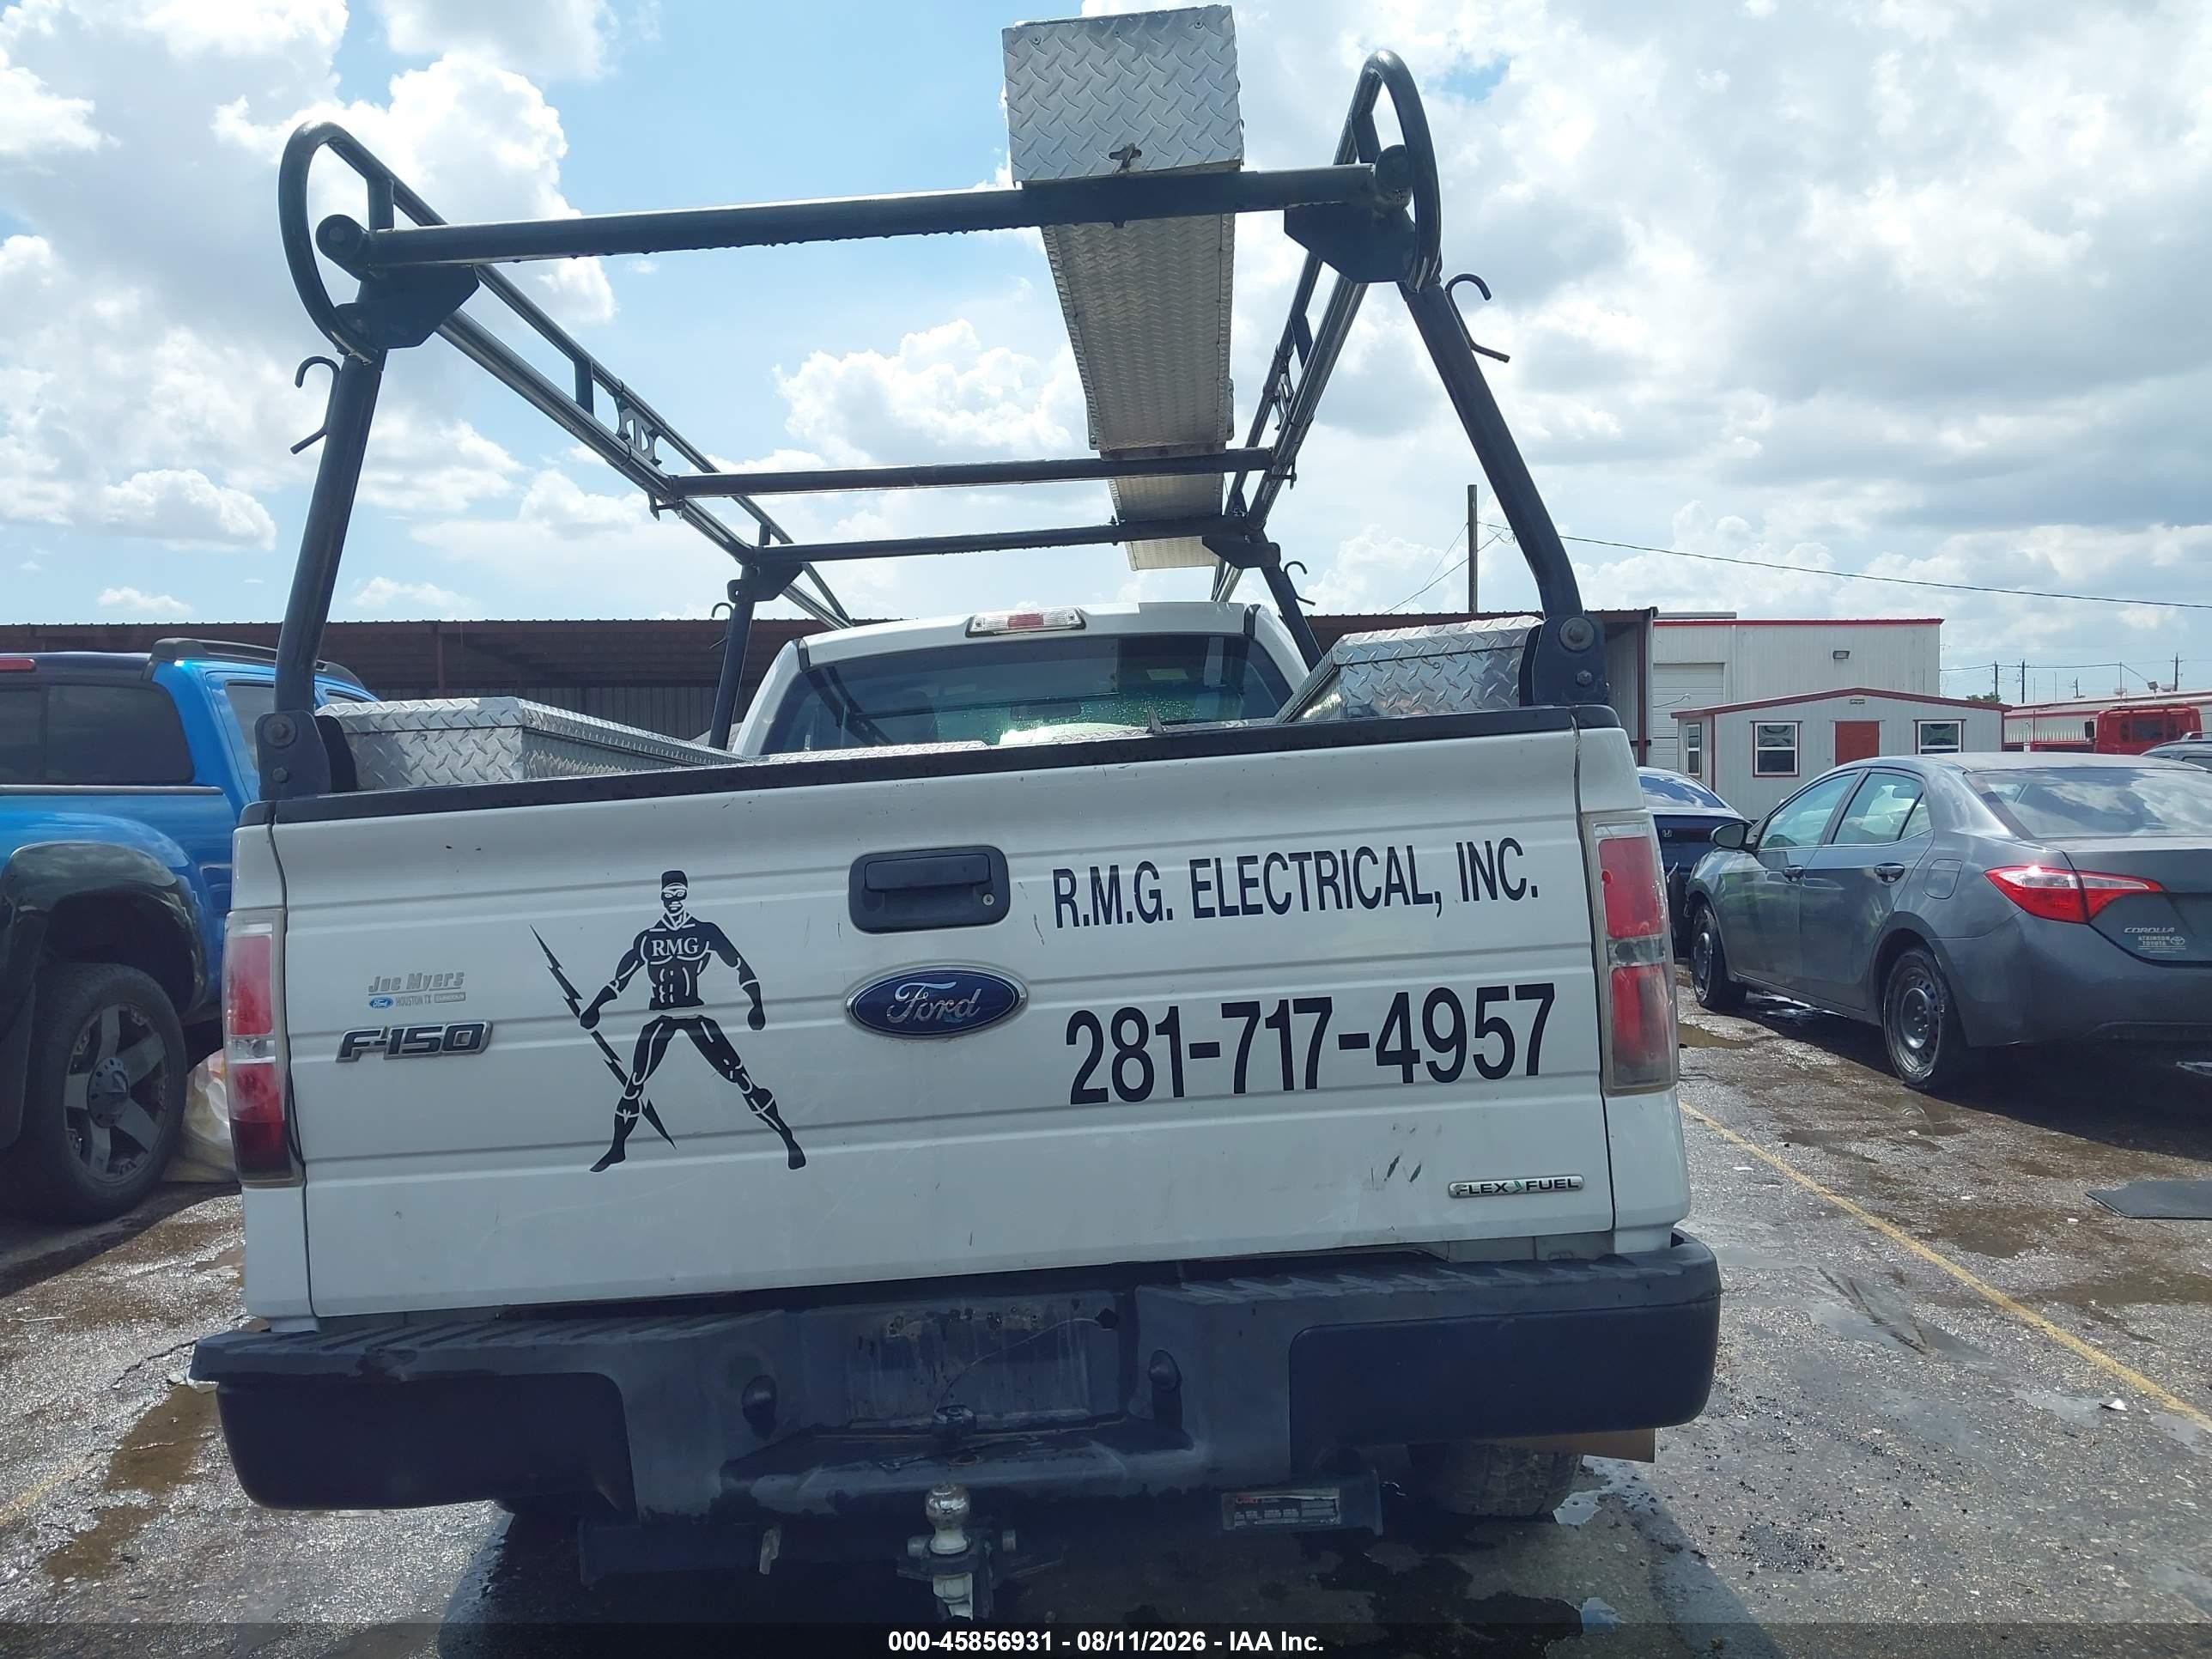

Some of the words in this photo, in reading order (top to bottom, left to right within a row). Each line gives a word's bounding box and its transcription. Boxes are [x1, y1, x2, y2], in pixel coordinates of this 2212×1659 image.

[1053, 860, 1174, 930] R.M.G.
[1188, 845, 1443, 919] ELECTRICAL,
[1455, 837, 1539, 902] INC.
[651, 937, 700, 957] RMG
[368, 975, 402, 994] Joe
[405, 971, 465, 992] Myers
[395, 995, 422, 1006] HOUSTON
[885, 981, 983, 1024] Ford
[336, 1020, 493, 1063] F-150
[1066, 982, 1556, 1106] 281-717-4957
[1455, 1182, 1509, 1196] FLEX
[1525, 1178, 1579, 1192] FUEL
